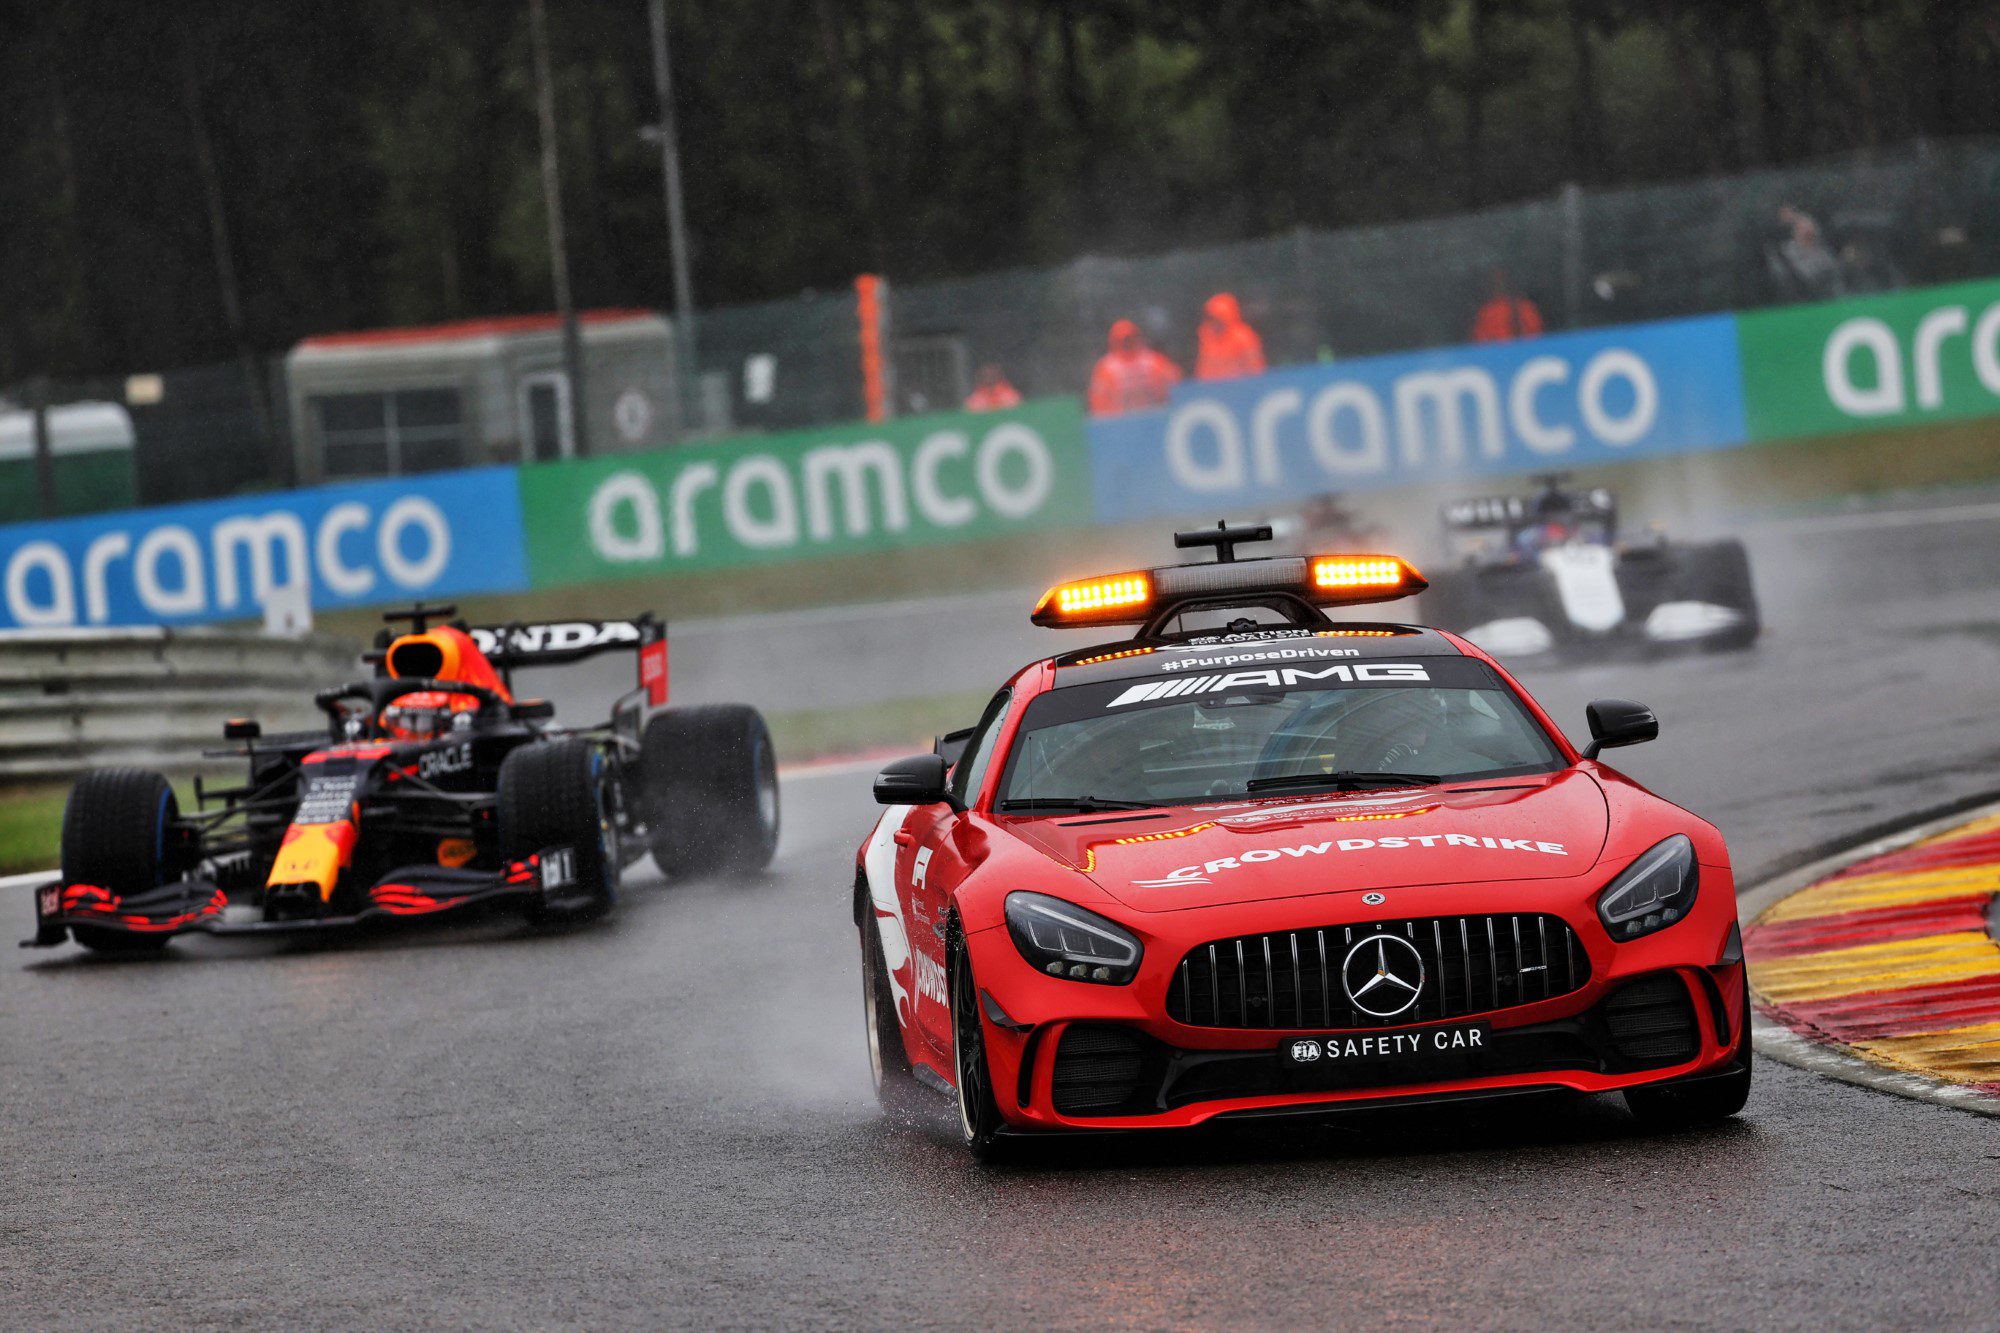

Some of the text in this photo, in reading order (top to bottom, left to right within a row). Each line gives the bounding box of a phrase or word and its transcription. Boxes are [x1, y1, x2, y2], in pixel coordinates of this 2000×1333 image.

[1165, 347, 1658, 489] aramco
[588, 422, 1054, 562] aramco
[5, 495, 452, 627] aramco
[470, 621, 641, 654] ONDA
[1161, 648, 1360, 671] #PurposeDriven
[1207, 663, 1431, 693] AMG
[418, 742, 473, 779] ORACLE
[1166, 832, 1569, 883] CROWDSTRIKE
[1326, 1033, 1421, 1058] SAFETY
[1434, 1028, 1483, 1050] CAR
